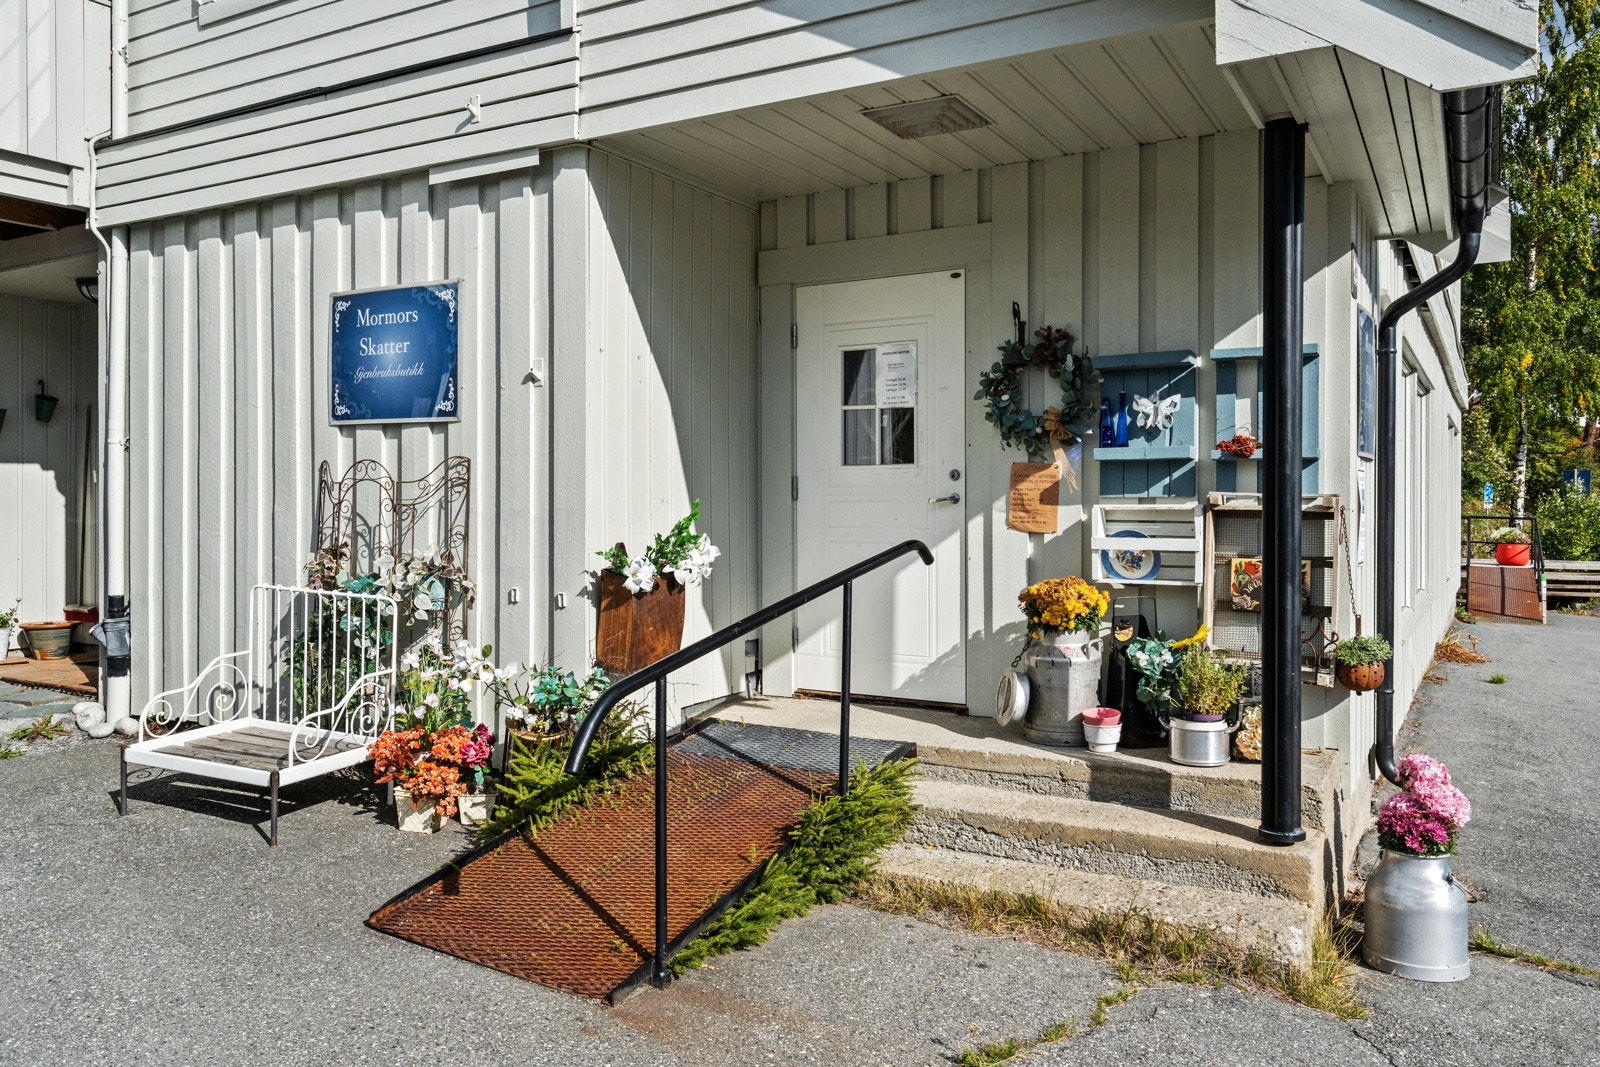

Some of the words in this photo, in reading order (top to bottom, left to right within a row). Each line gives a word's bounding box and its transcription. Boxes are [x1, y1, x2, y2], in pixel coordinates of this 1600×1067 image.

[356, 308, 419, 328] Mormors
[359, 337, 410, 356] Skatter
[354, 362, 426, 384] Gjenbruksbutikk
